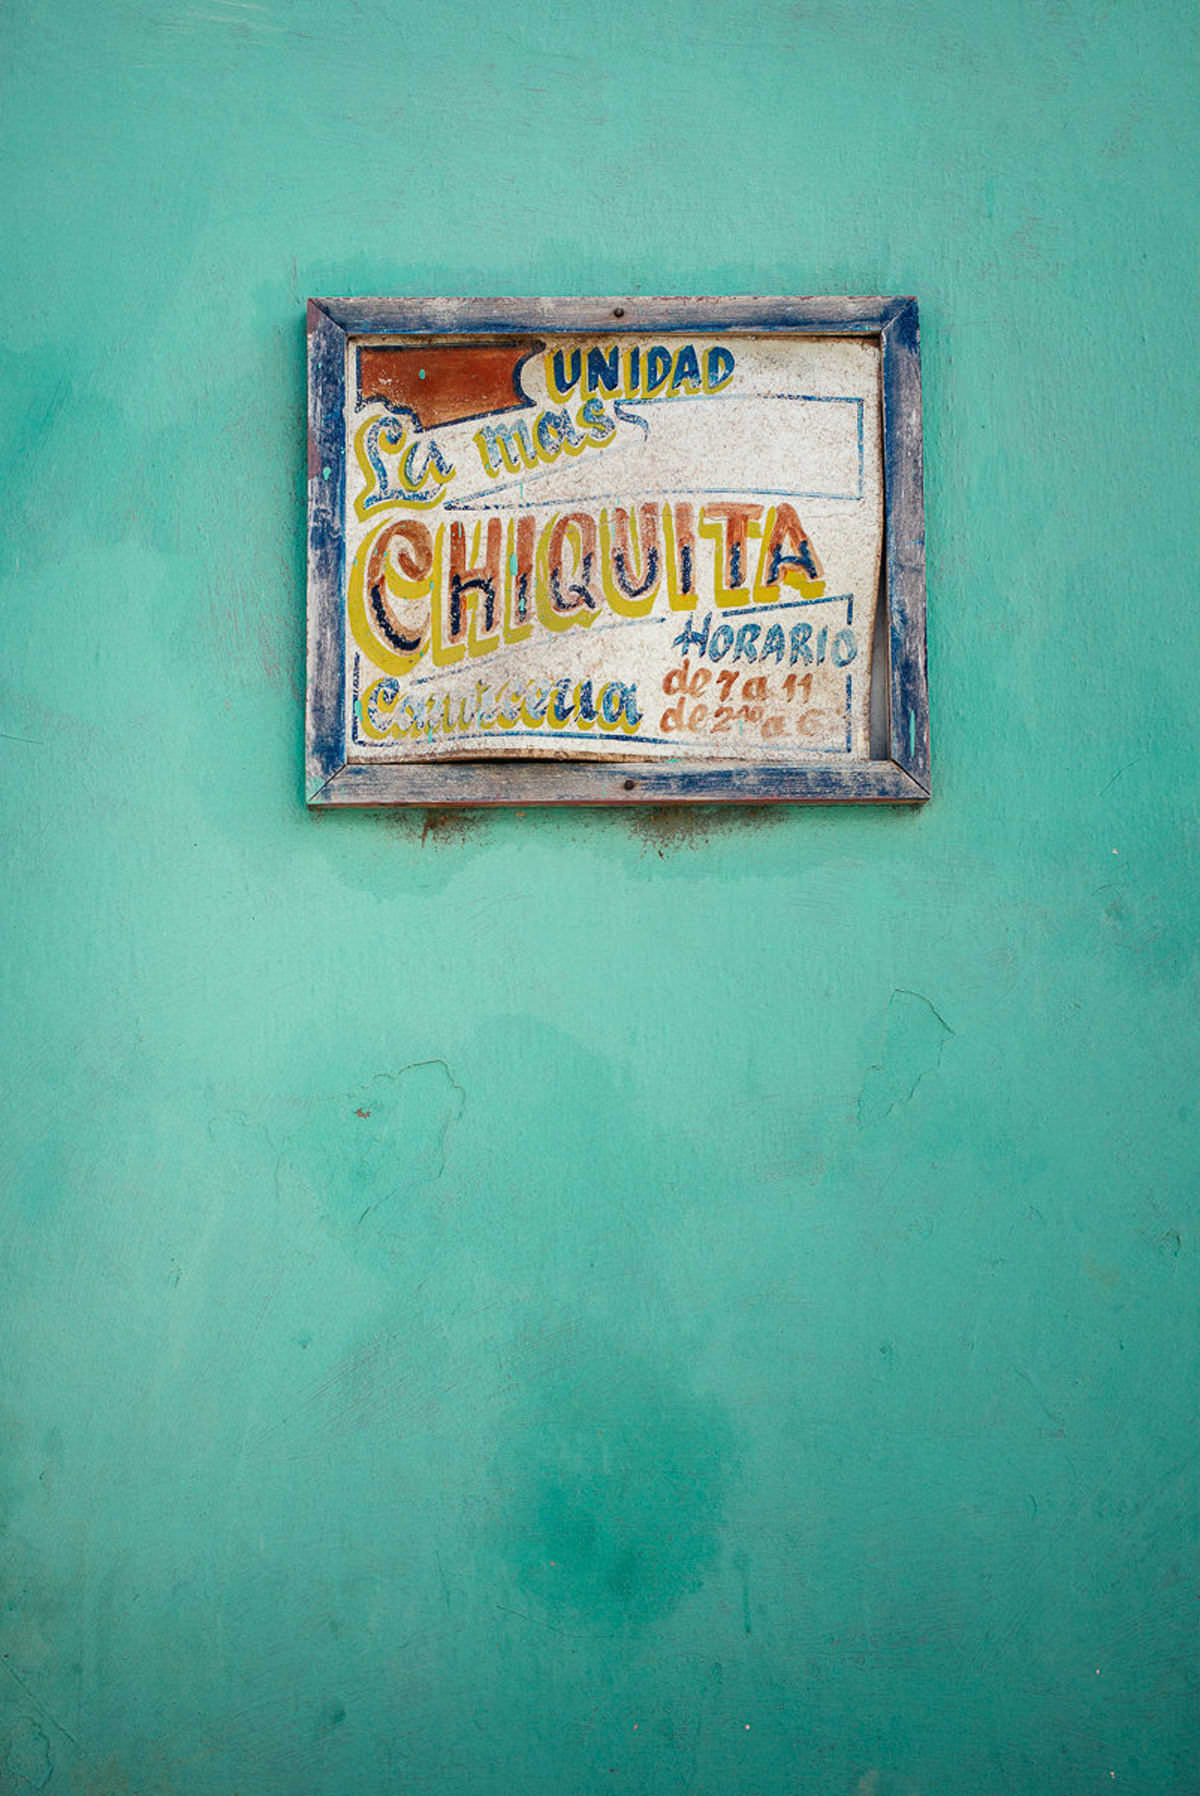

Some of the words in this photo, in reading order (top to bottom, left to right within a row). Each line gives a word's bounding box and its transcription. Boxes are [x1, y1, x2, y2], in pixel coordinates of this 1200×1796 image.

[544, 344, 735, 403] UNIDAD
[353, 414, 456, 523] La
[347, 502, 826, 676] CHIQUITA
[671, 611, 858, 668] HORARIO
[662, 658, 713, 698] de
[716, 669, 740, 702] 7
[741, 676, 769, 701] a
[781, 672, 814, 704] 11
[659, 696, 709, 734] de
